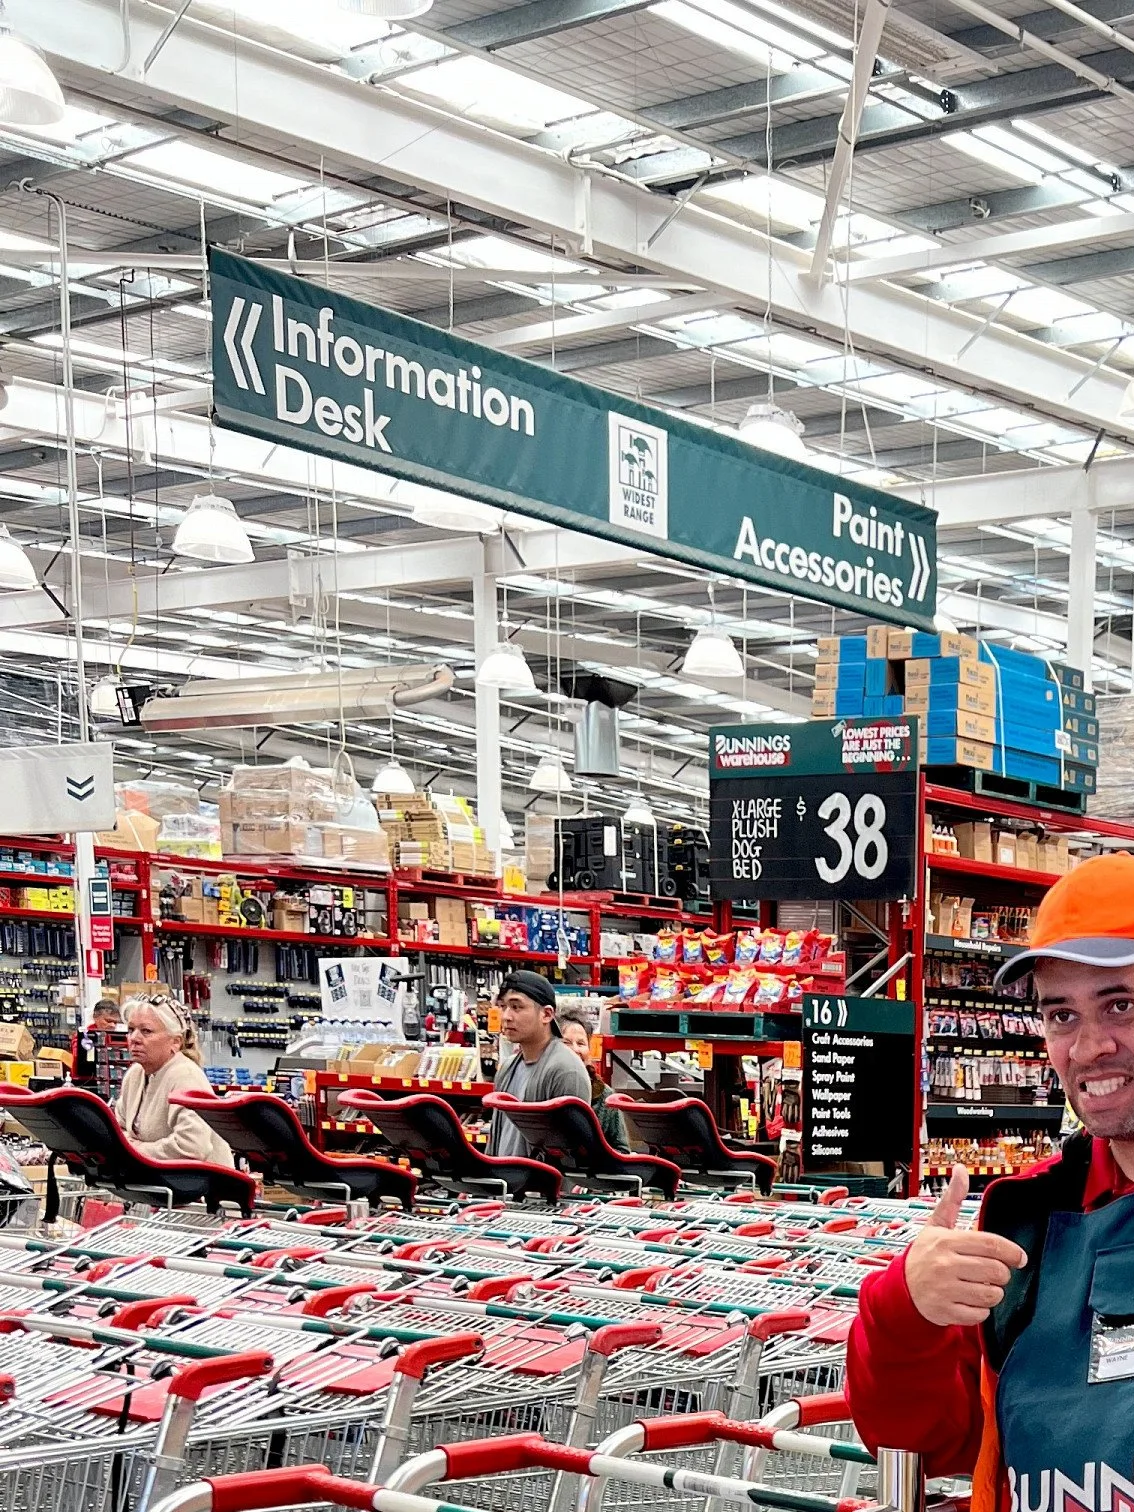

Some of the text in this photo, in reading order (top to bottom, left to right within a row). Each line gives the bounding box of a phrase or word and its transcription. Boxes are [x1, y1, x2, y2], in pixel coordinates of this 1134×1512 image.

[273, 294, 534, 437] Information
[276, 365, 393, 455] Desk
[621, 487, 656, 508] WIDEST
[623, 505, 655, 527] RANGE
[833, 492, 903, 557] Paint
[733, 517, 904, 608] Accessories
[843, 726, 910, 739] LOWEST PRICES
[716, 735, 791, 754] BUNNINGS
[843, 738, 901, 751] ARE JUST THE
[719, 752, 785, 767] warehouse
[732, 798, 782, 819] X-LARGE
[732, 818, 778, 839] PLUSH
[732, 839, 762, 859] DOG
[733, 859, 762, 880] BED
[812, 999, 832, 1024] 16
[812, 1033, 874, 1047] Craft Accessories
[812, 1051, 855, 1066] Sand Paper
[812, 1069, 855, 1084] Spray Paint
[812, 1088, 851, 1102] Wallpaper
[812, 1107, 851, 1119] Paint Tools
[957, 1106, 993, 1118] Woodworking
[812, 1126, 849, 1137] Adhesives
[812, 1144, 842, 1156] Silicones
